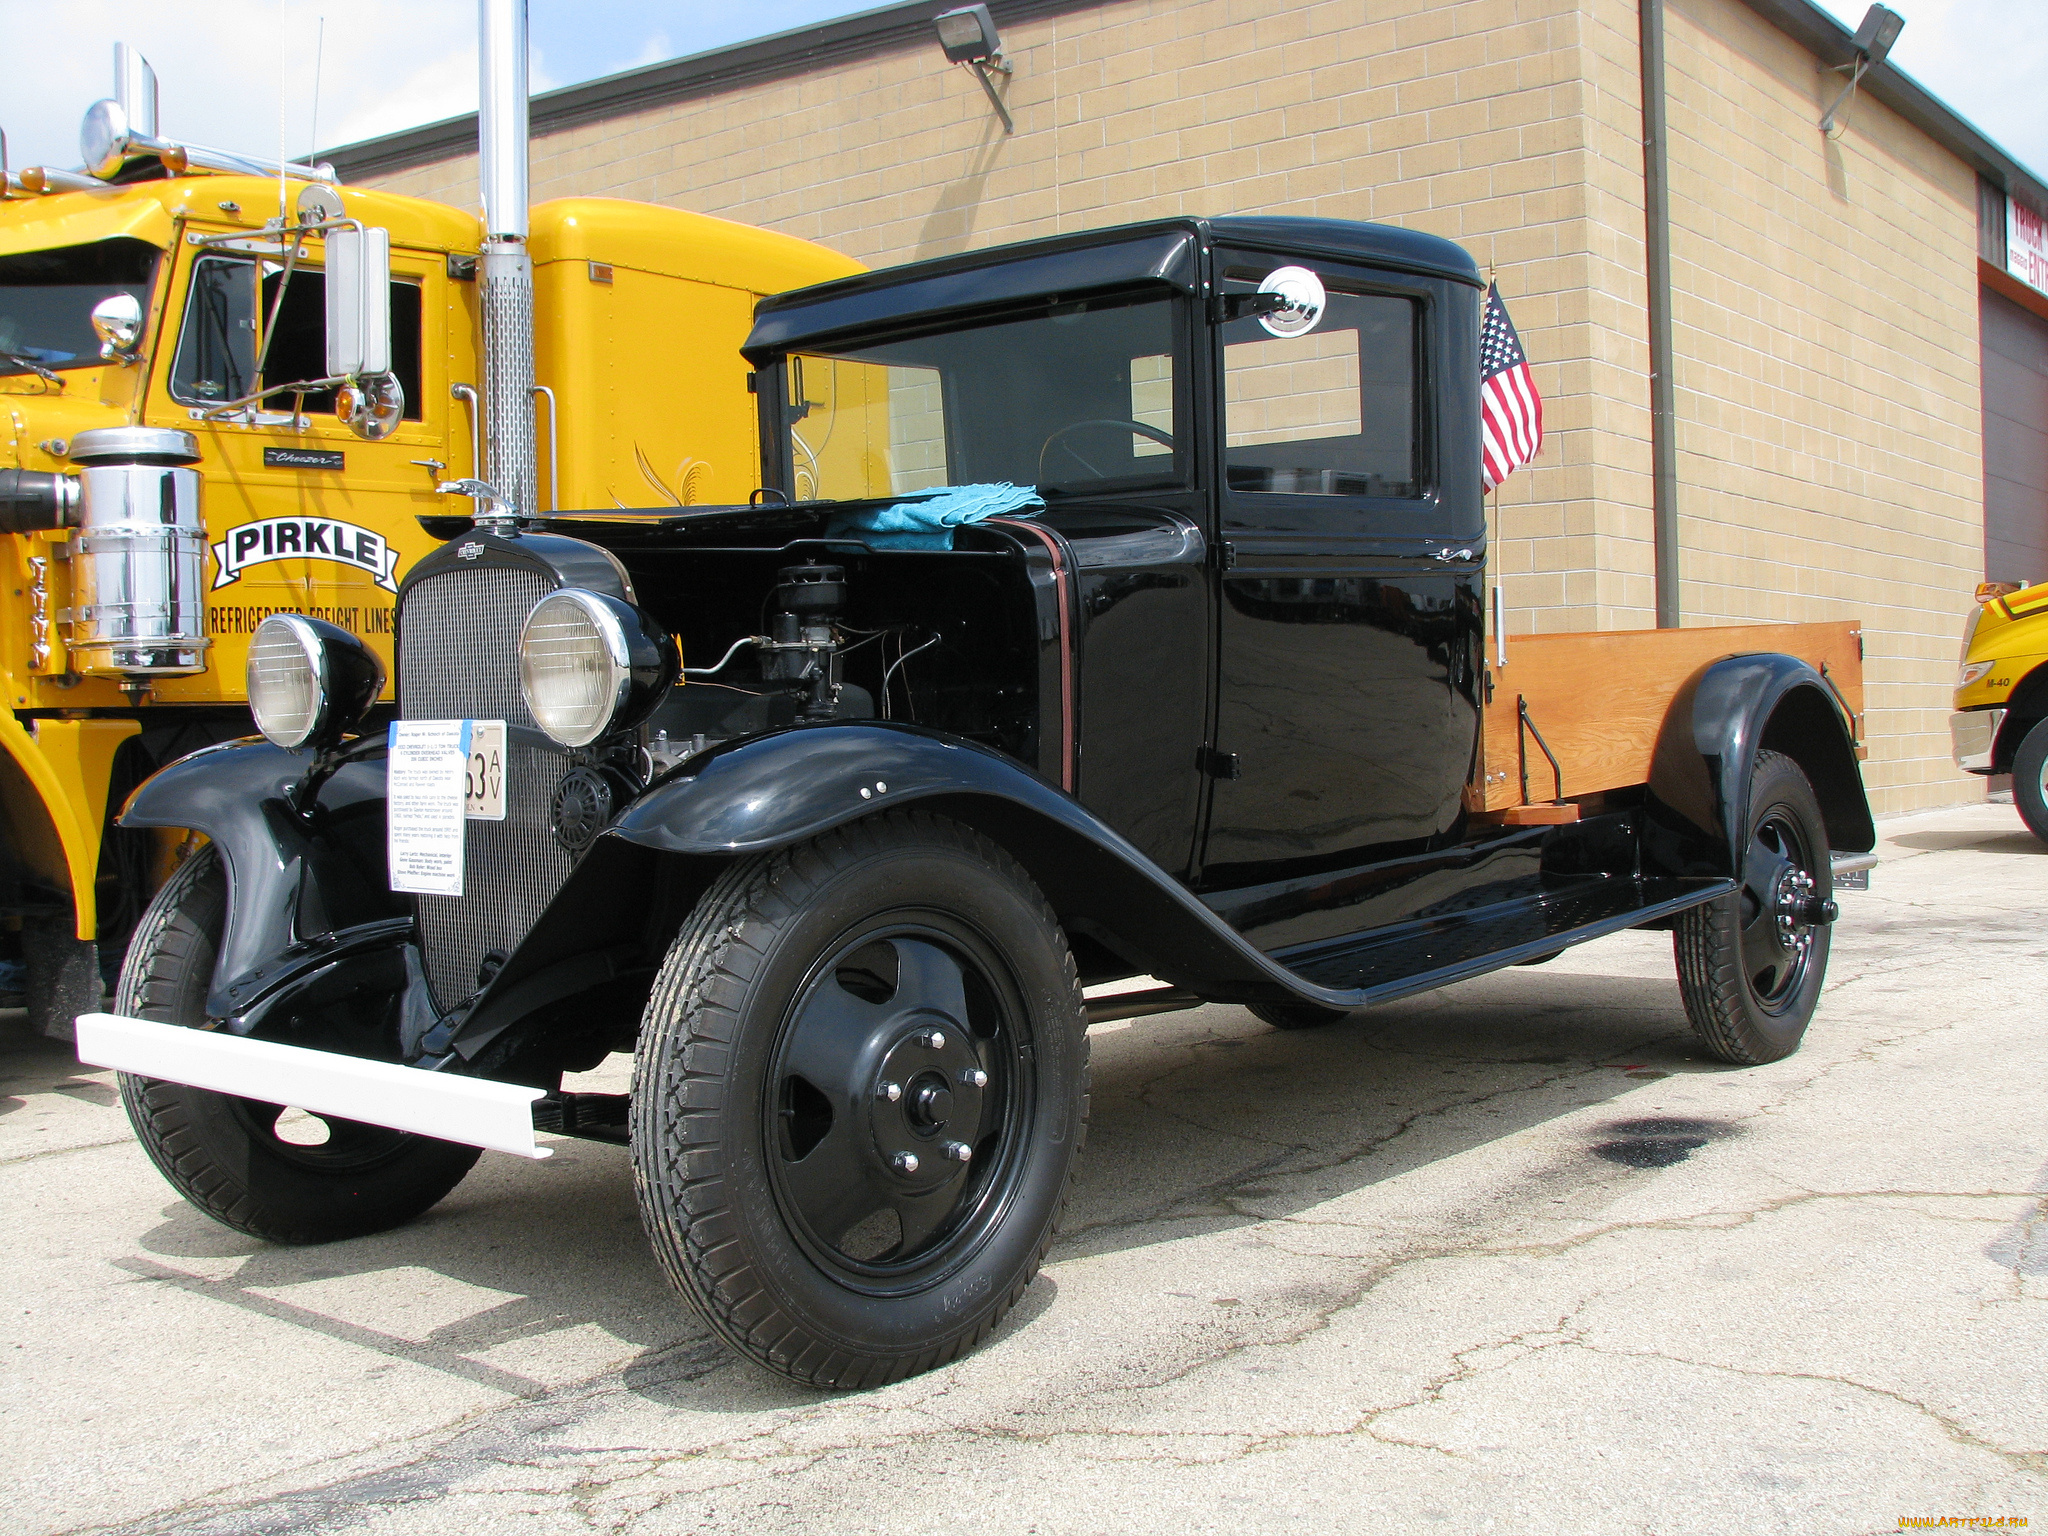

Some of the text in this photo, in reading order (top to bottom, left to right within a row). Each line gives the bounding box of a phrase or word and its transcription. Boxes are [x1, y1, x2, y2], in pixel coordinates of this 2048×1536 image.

[276, 452, 332, 465] Cheezer
[236, 522, 378, 568] PIRKLE
[365, 608, 396, 634] LINES
[1986, 678, 2010, 688] M-40
